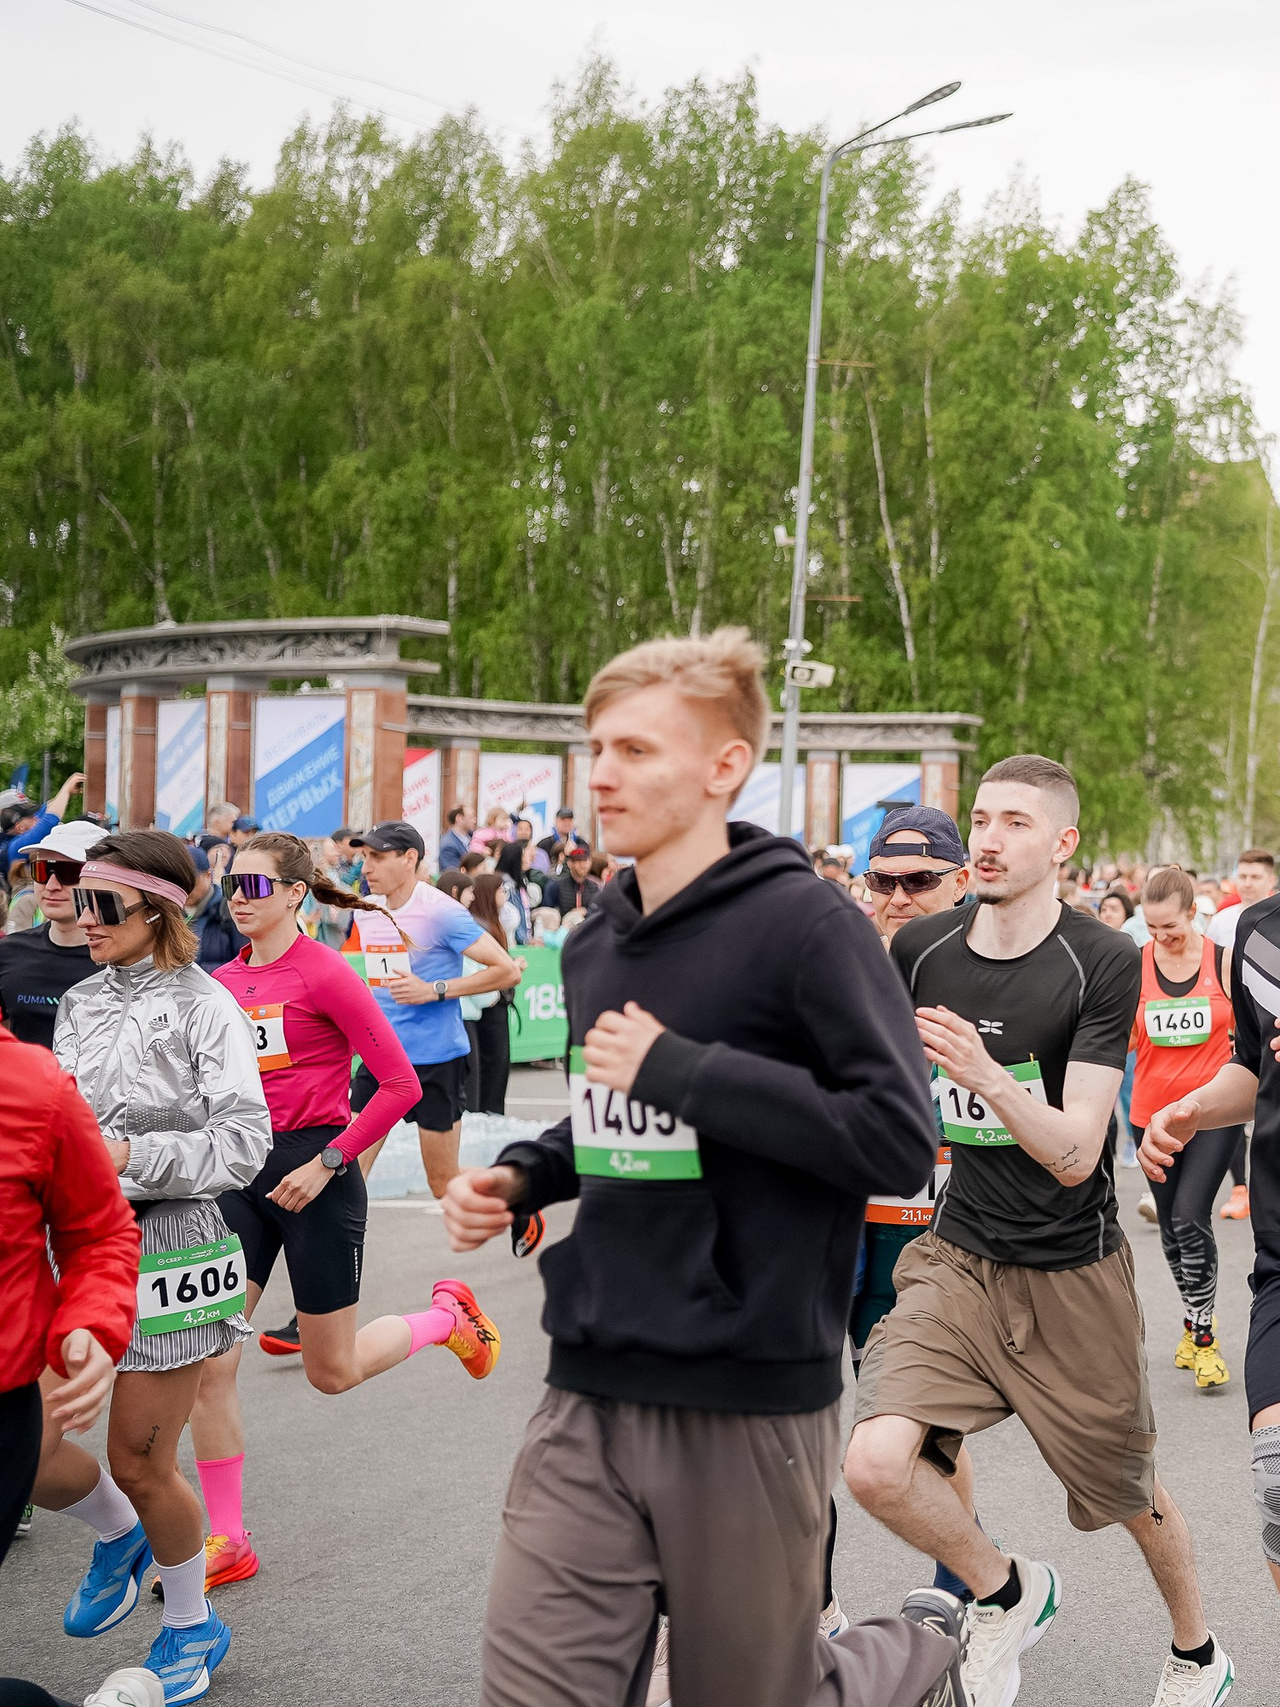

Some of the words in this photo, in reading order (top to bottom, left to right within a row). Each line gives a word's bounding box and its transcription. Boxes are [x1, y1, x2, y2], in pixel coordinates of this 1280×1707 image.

[266, 742, 341, 810] ДВИЖЕНИЕ
[261, 766, 343, 831] ПЕРВЫХ
[381, 957, 388, 974] 1
[17, 994, 46, 1004] PUMA
[1153, 1011, 1204, 1032] 1460
[151, 1260, 239, 1308] 1606
